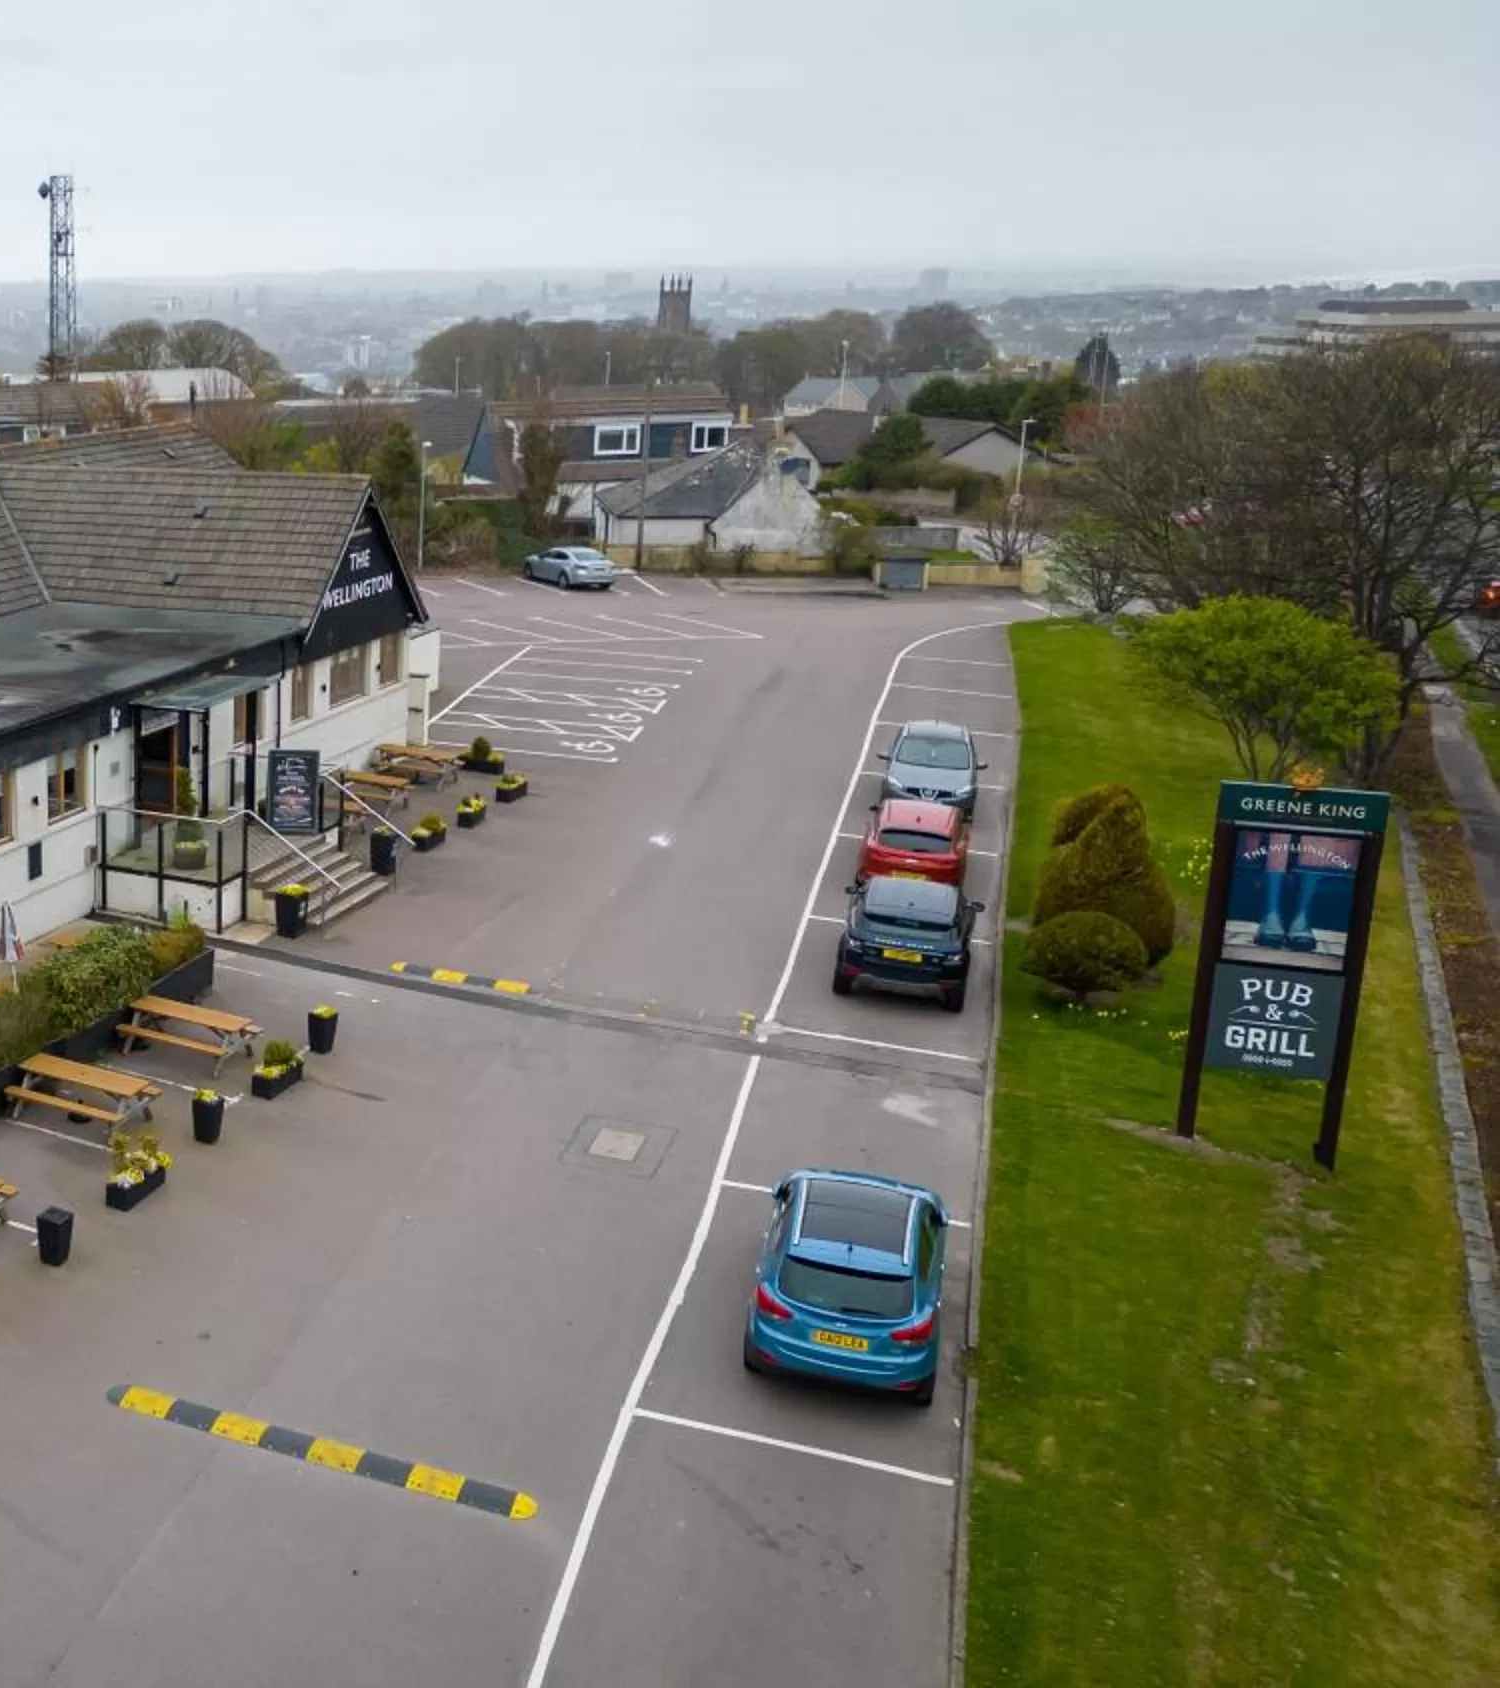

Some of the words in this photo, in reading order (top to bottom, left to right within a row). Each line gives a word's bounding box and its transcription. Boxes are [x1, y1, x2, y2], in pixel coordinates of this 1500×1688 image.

[349, 548, 371, 572] THE
[321, 571, 394, 611] WELLINGTON
[1241, 797, 1312, 815] GREENE
[1318, 803, 1367, 819] KING
[1243, 846, 1268, 860] THE
[1269, 843, 1351, 870] WELLINGTON
[1240, 978, 1314, 1007] PUB
[1265, 1003, 1284, 1021] &
[1224, 1025, 1315, 1058] GRILL
